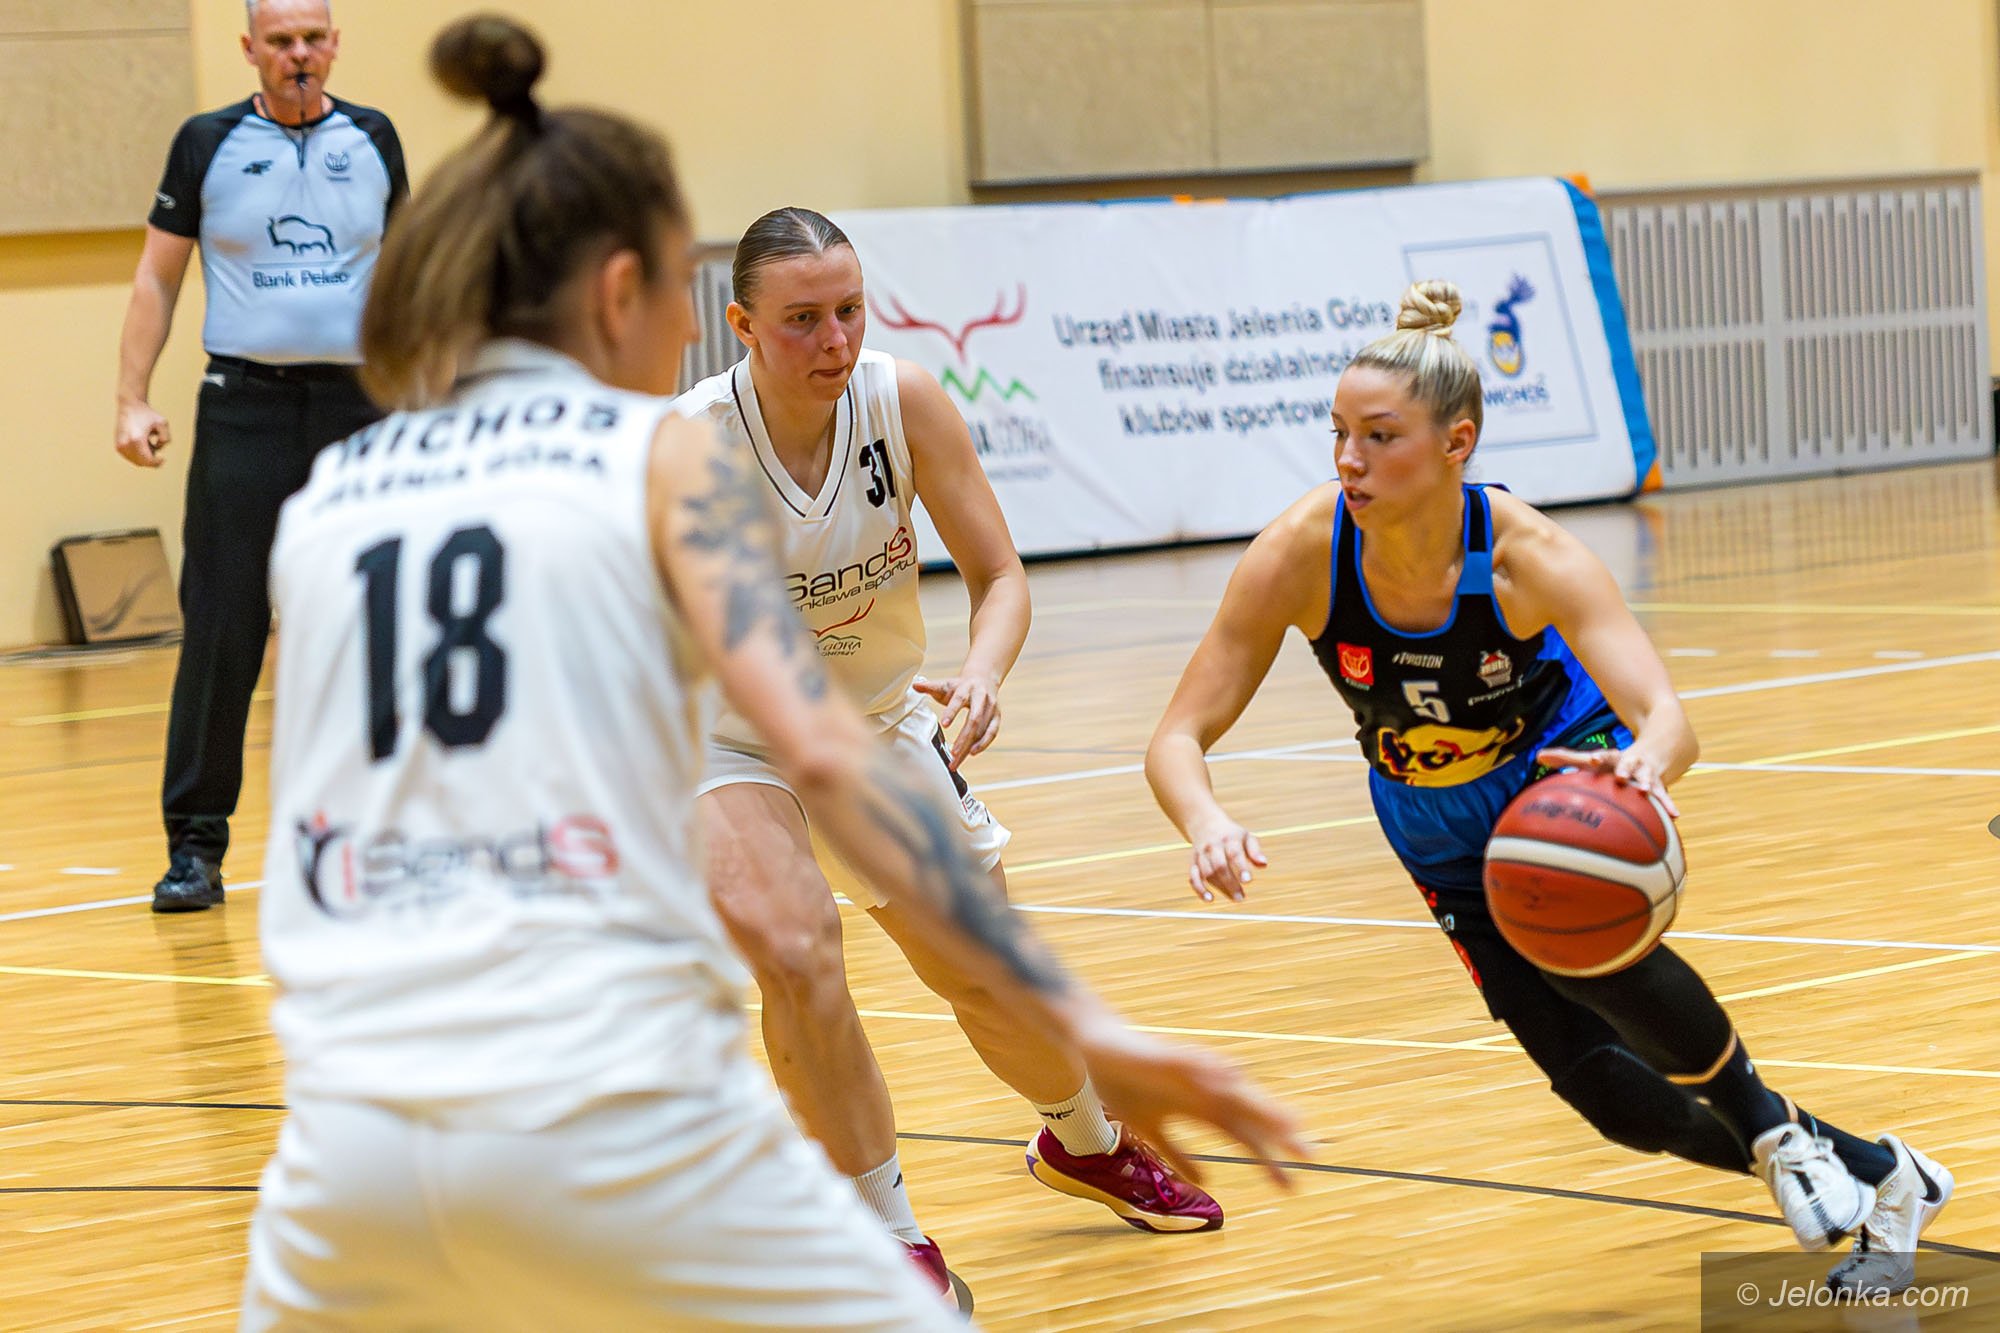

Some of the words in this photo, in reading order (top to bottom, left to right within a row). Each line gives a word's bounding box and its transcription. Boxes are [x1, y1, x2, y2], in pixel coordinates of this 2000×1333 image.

[252, 270, 297, 288] Bank
[300, 269, 352, 285] Pekao
[1137, 309, 1220, 341] Miasta
[1228, 300, 1323, 340] Jelenia
[1326, 297, 1394, 330] Góra
[1098, 357, 1218, 394] finansuje
[1220, 396, 1334, 436] sportow
[859, 438, 897, 508] 31
[864, 557, 916, 590] sportu
[355, 525, 509, 762] 18
[1401, 680, 1451, 723] 5
